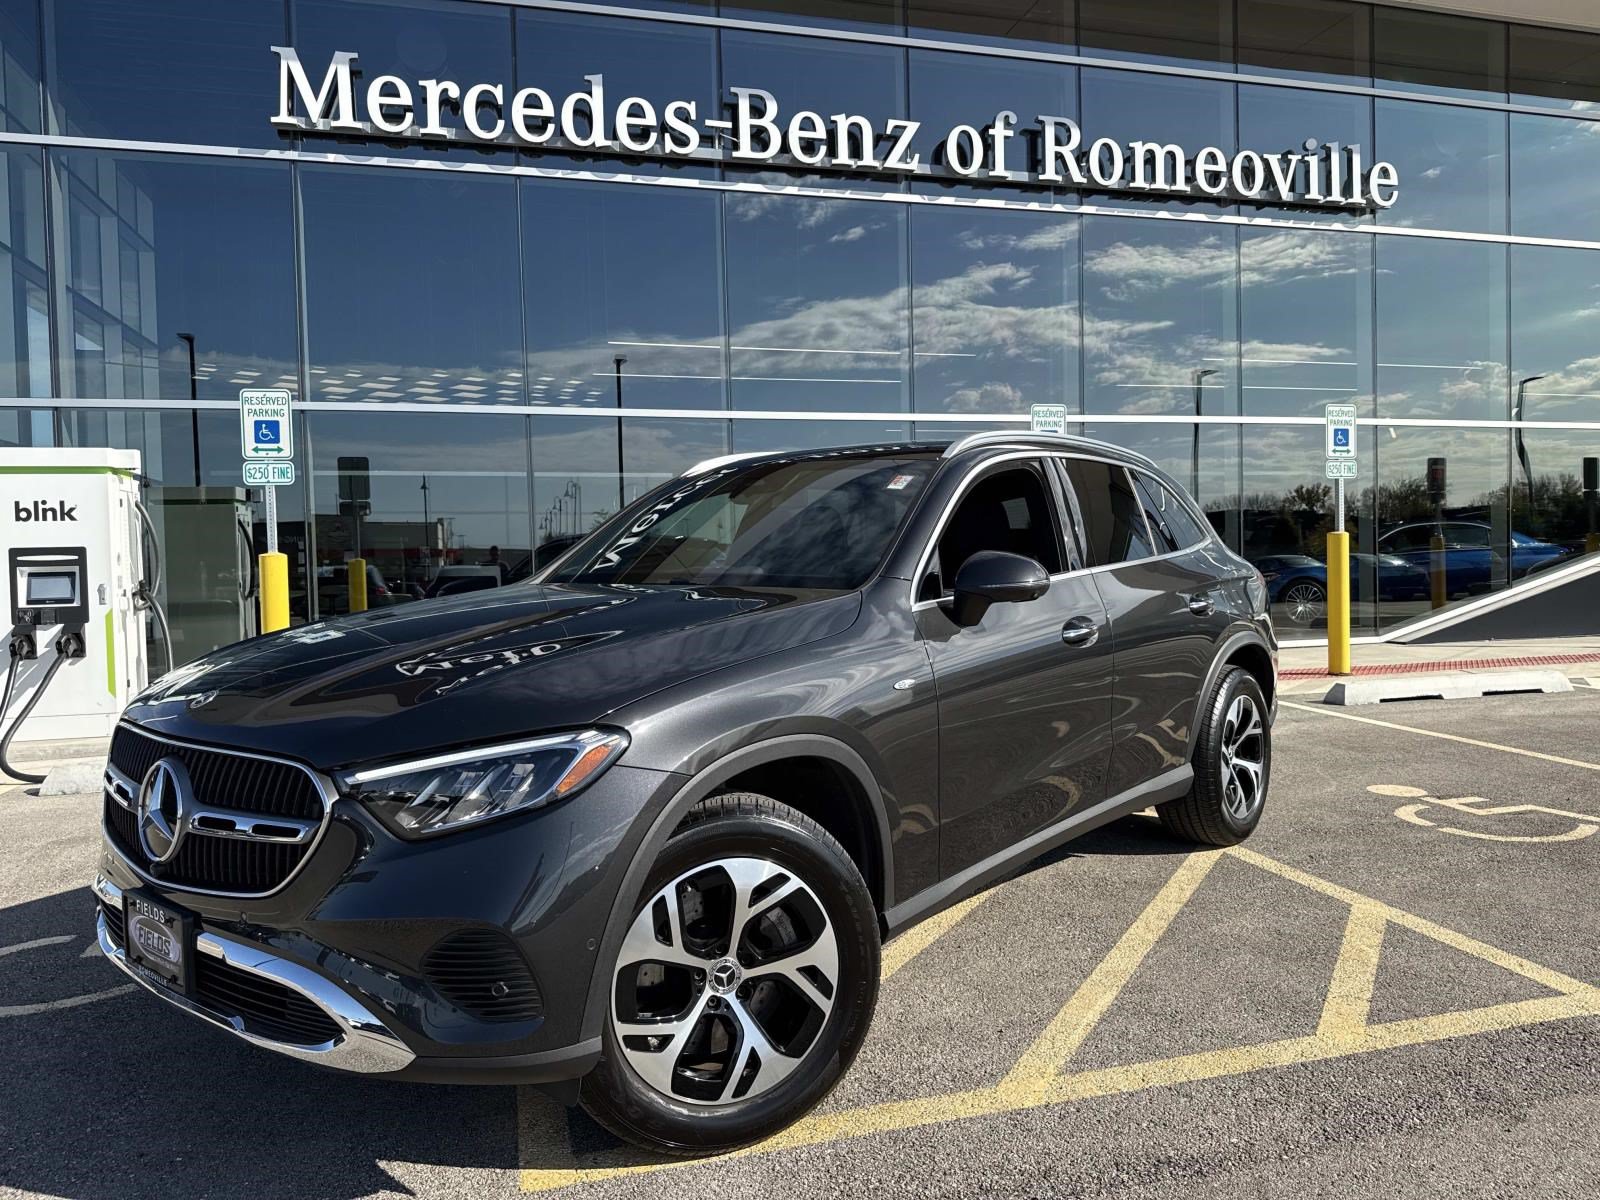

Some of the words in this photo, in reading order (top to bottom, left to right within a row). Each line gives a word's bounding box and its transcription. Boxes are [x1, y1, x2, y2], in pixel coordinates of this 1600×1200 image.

[270, 46, 921, 171] Mercedes-Benz
[946, 111, 1018, 177] of
[1036, 115, 1399, 208] Romeoville
[243, 396, 287, 406] RESERVED
[247, 408, 285, 417] PARKING
[1033, 410, 1064, 418] RESERVED
[1328, 409, 1354, 418] RESERVED
[1036, 420, 1062, 428] PARKING
[1329, 418, 1352, 427] PARKING
[247, 466, 269, 480] $250
[272, 466, 291, 480] FINE
[1343, 463, 1356, 475] FINE
[14, 499, 78, 522] blink
[136, 900, 165, 923] FIELDS
[136, 923, 172, 958] FIELDS
